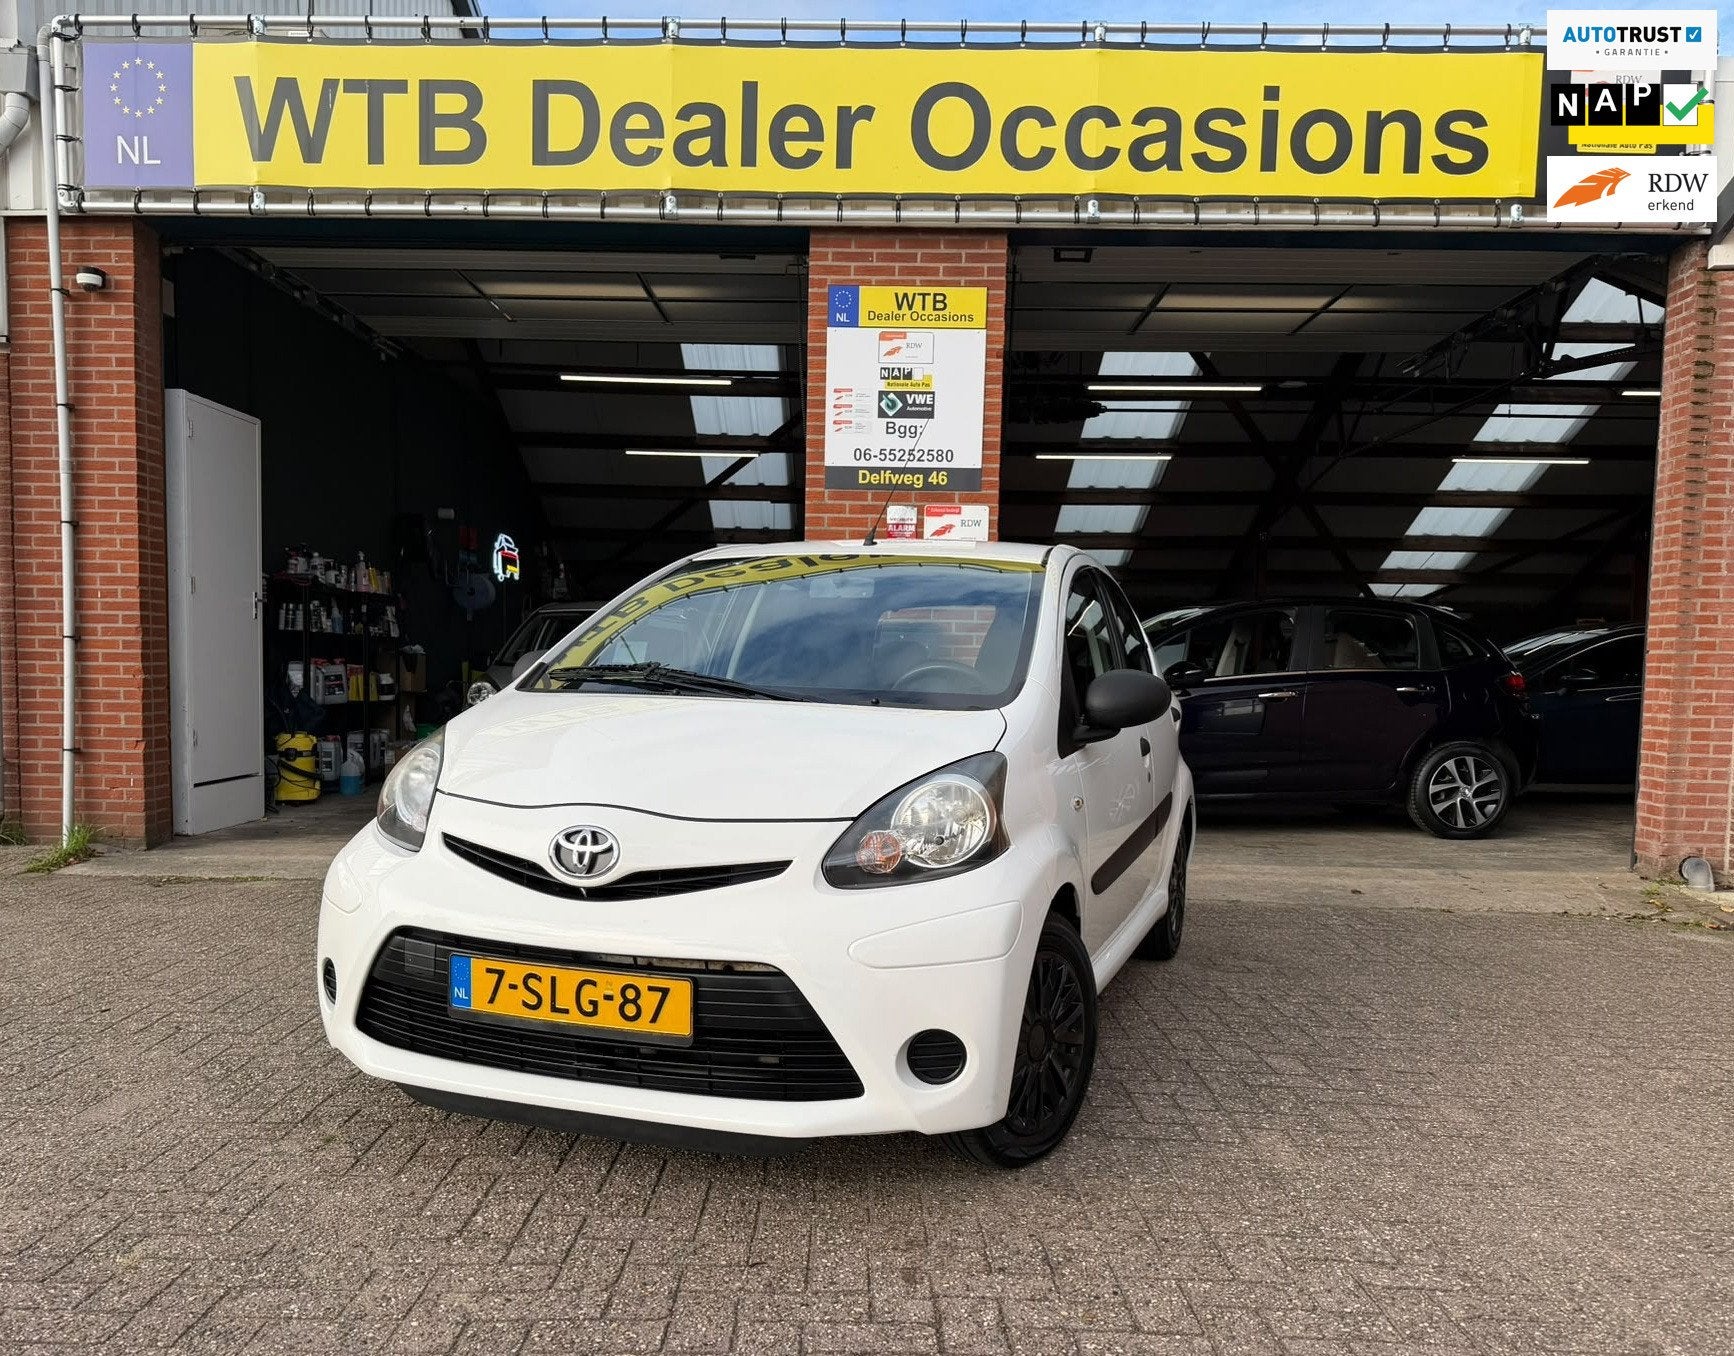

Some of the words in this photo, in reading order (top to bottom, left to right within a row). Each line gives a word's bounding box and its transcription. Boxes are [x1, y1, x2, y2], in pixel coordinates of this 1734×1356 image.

[233, 75, 488, 165] WTB
[531, 79, 875, 171] Dealer
[910, 81, 1490, 175] Occasions
[116, 134, 161, 165] NL
[894, 292, 948, 311] WTB
[835, 313, 850, 322] NL
[867, 310, 906, 321] Dealer
[910, 311, 974, 322] Occasions
[906, 393, 934, 405] VWE
[853, 447, 954, 463] 06-55252580
[858, 469, 924, 488] Delfweg
[928, 470, 948, 486] 46
[960, 519, 982, 527] RDW
[453, 986, 469, 999] NL
[484, 967, 672, 1024] 7-SLG-87
